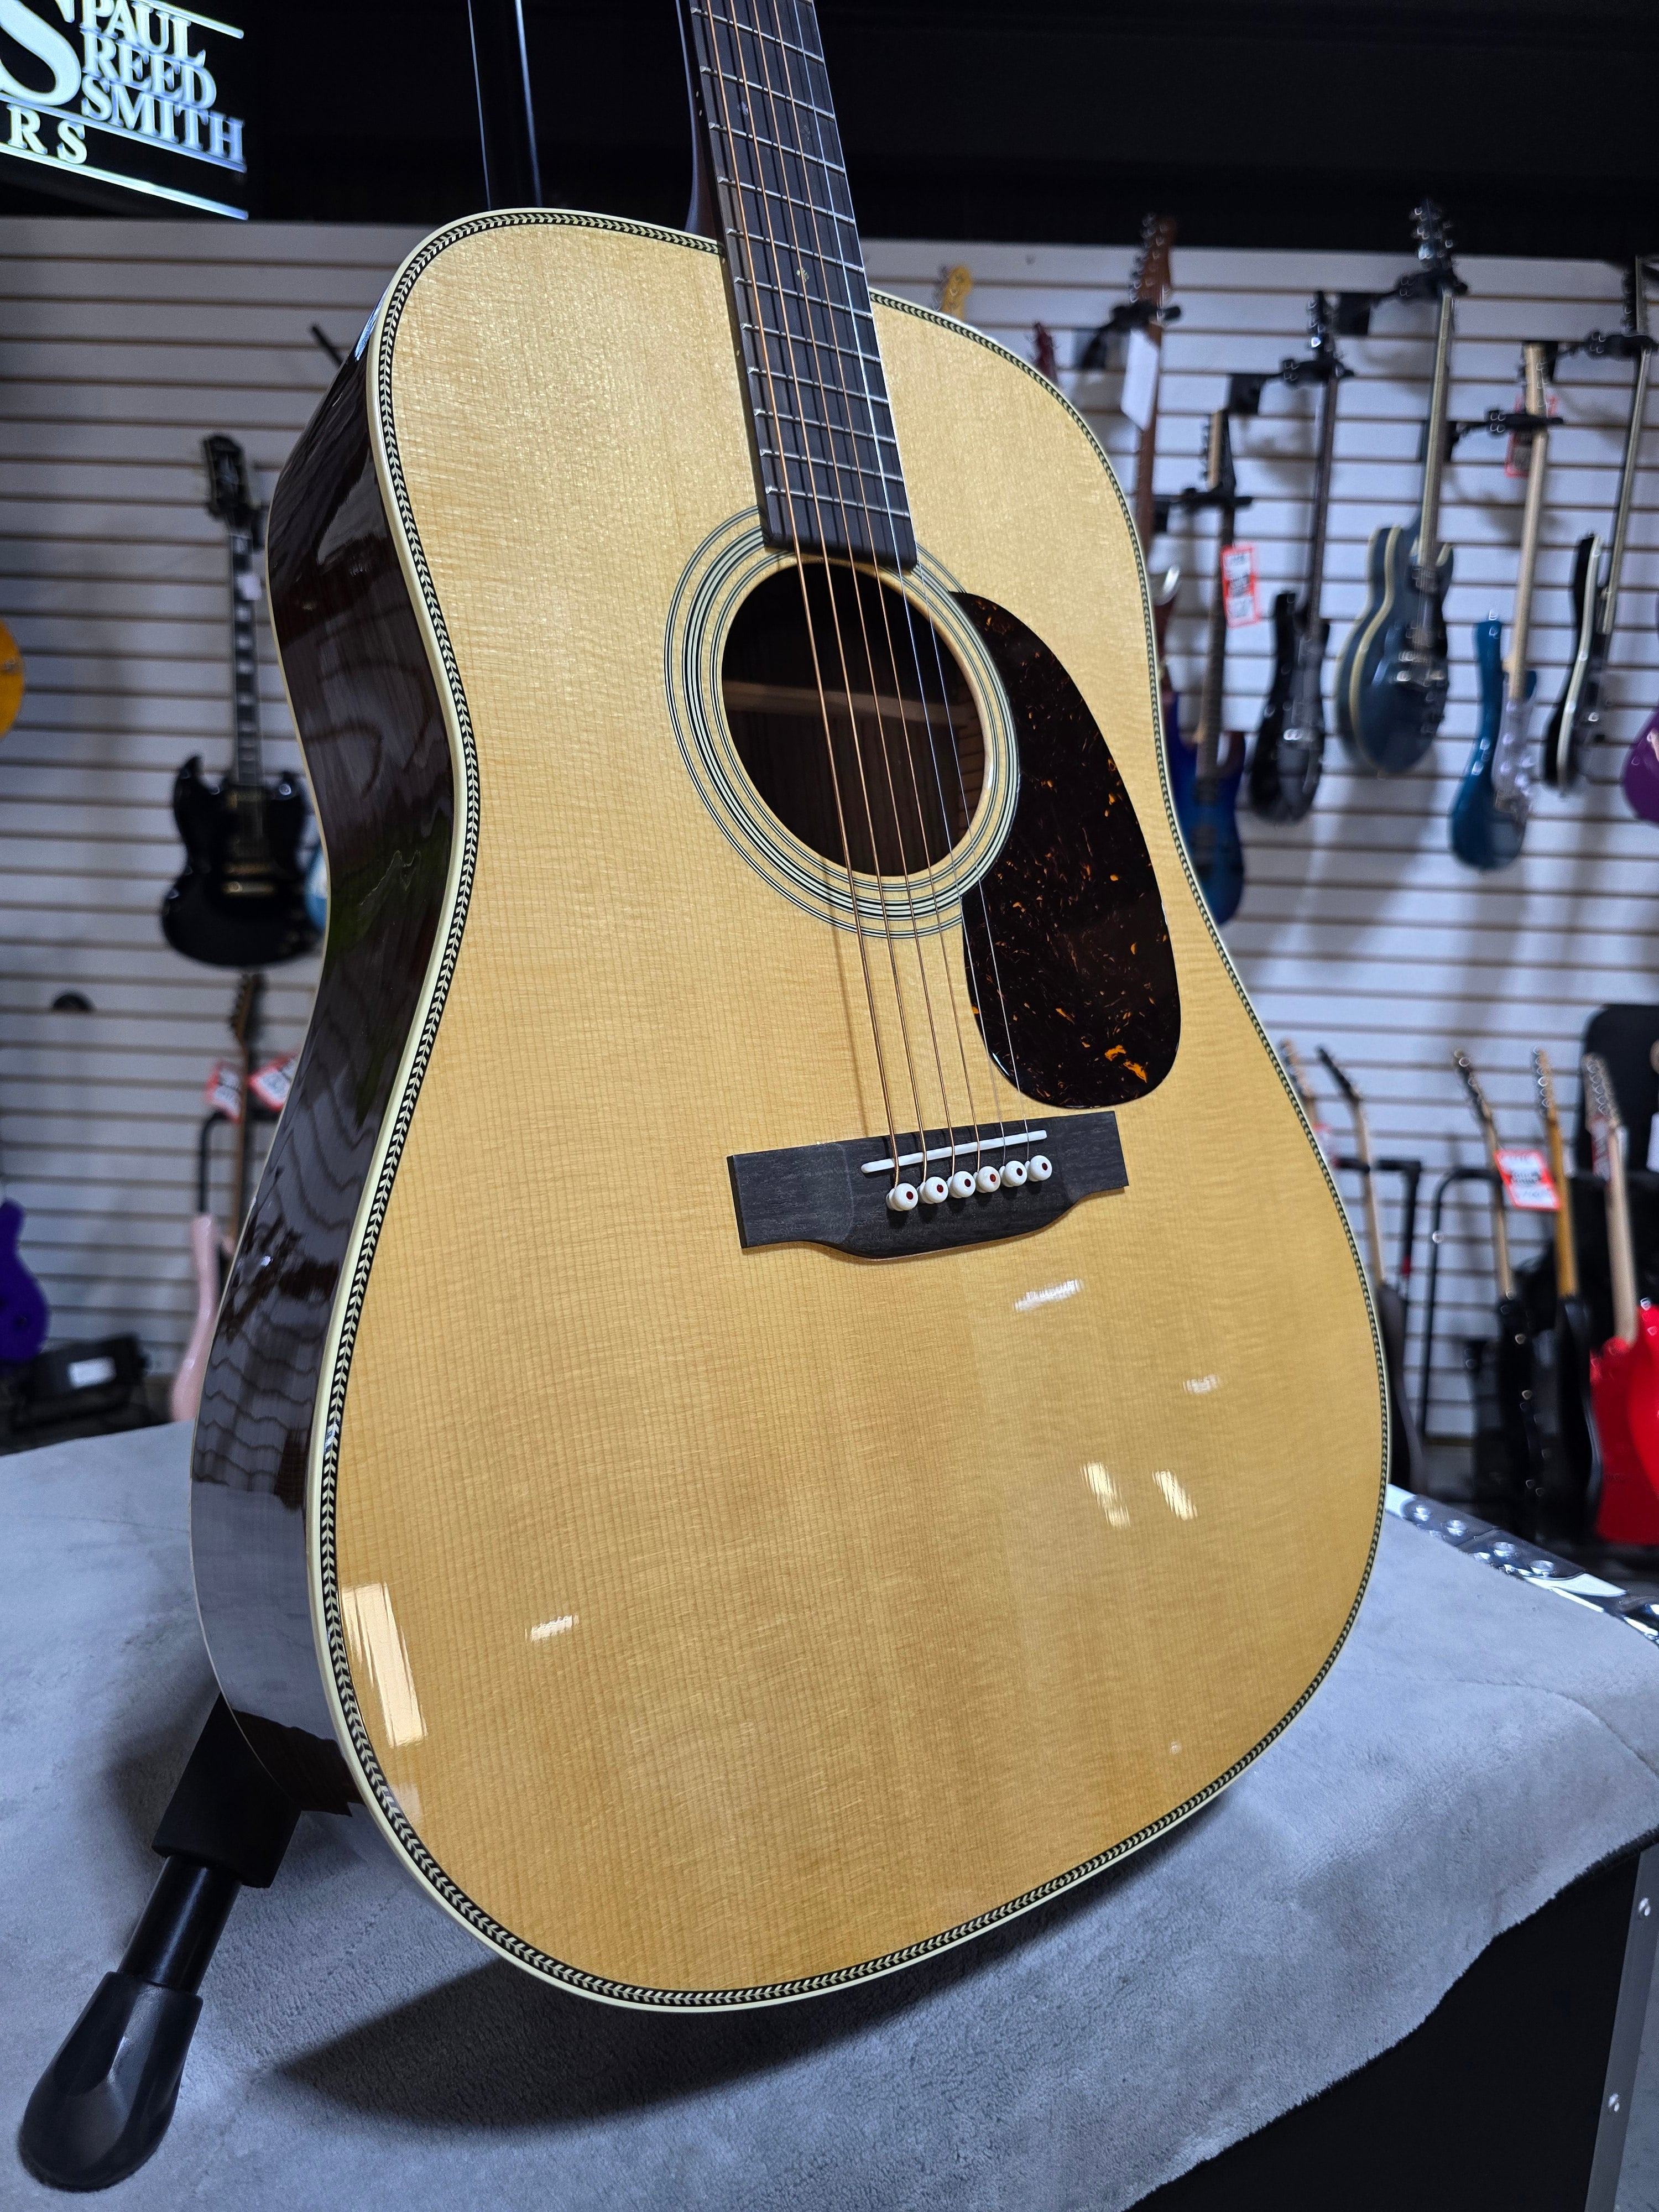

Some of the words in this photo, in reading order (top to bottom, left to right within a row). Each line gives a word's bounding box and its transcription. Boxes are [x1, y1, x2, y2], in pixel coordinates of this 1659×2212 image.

[80, 0, 206, 67] PAUL
[80, 28, 217, 109] REED
[81, 74, 244, 163] SMITH
